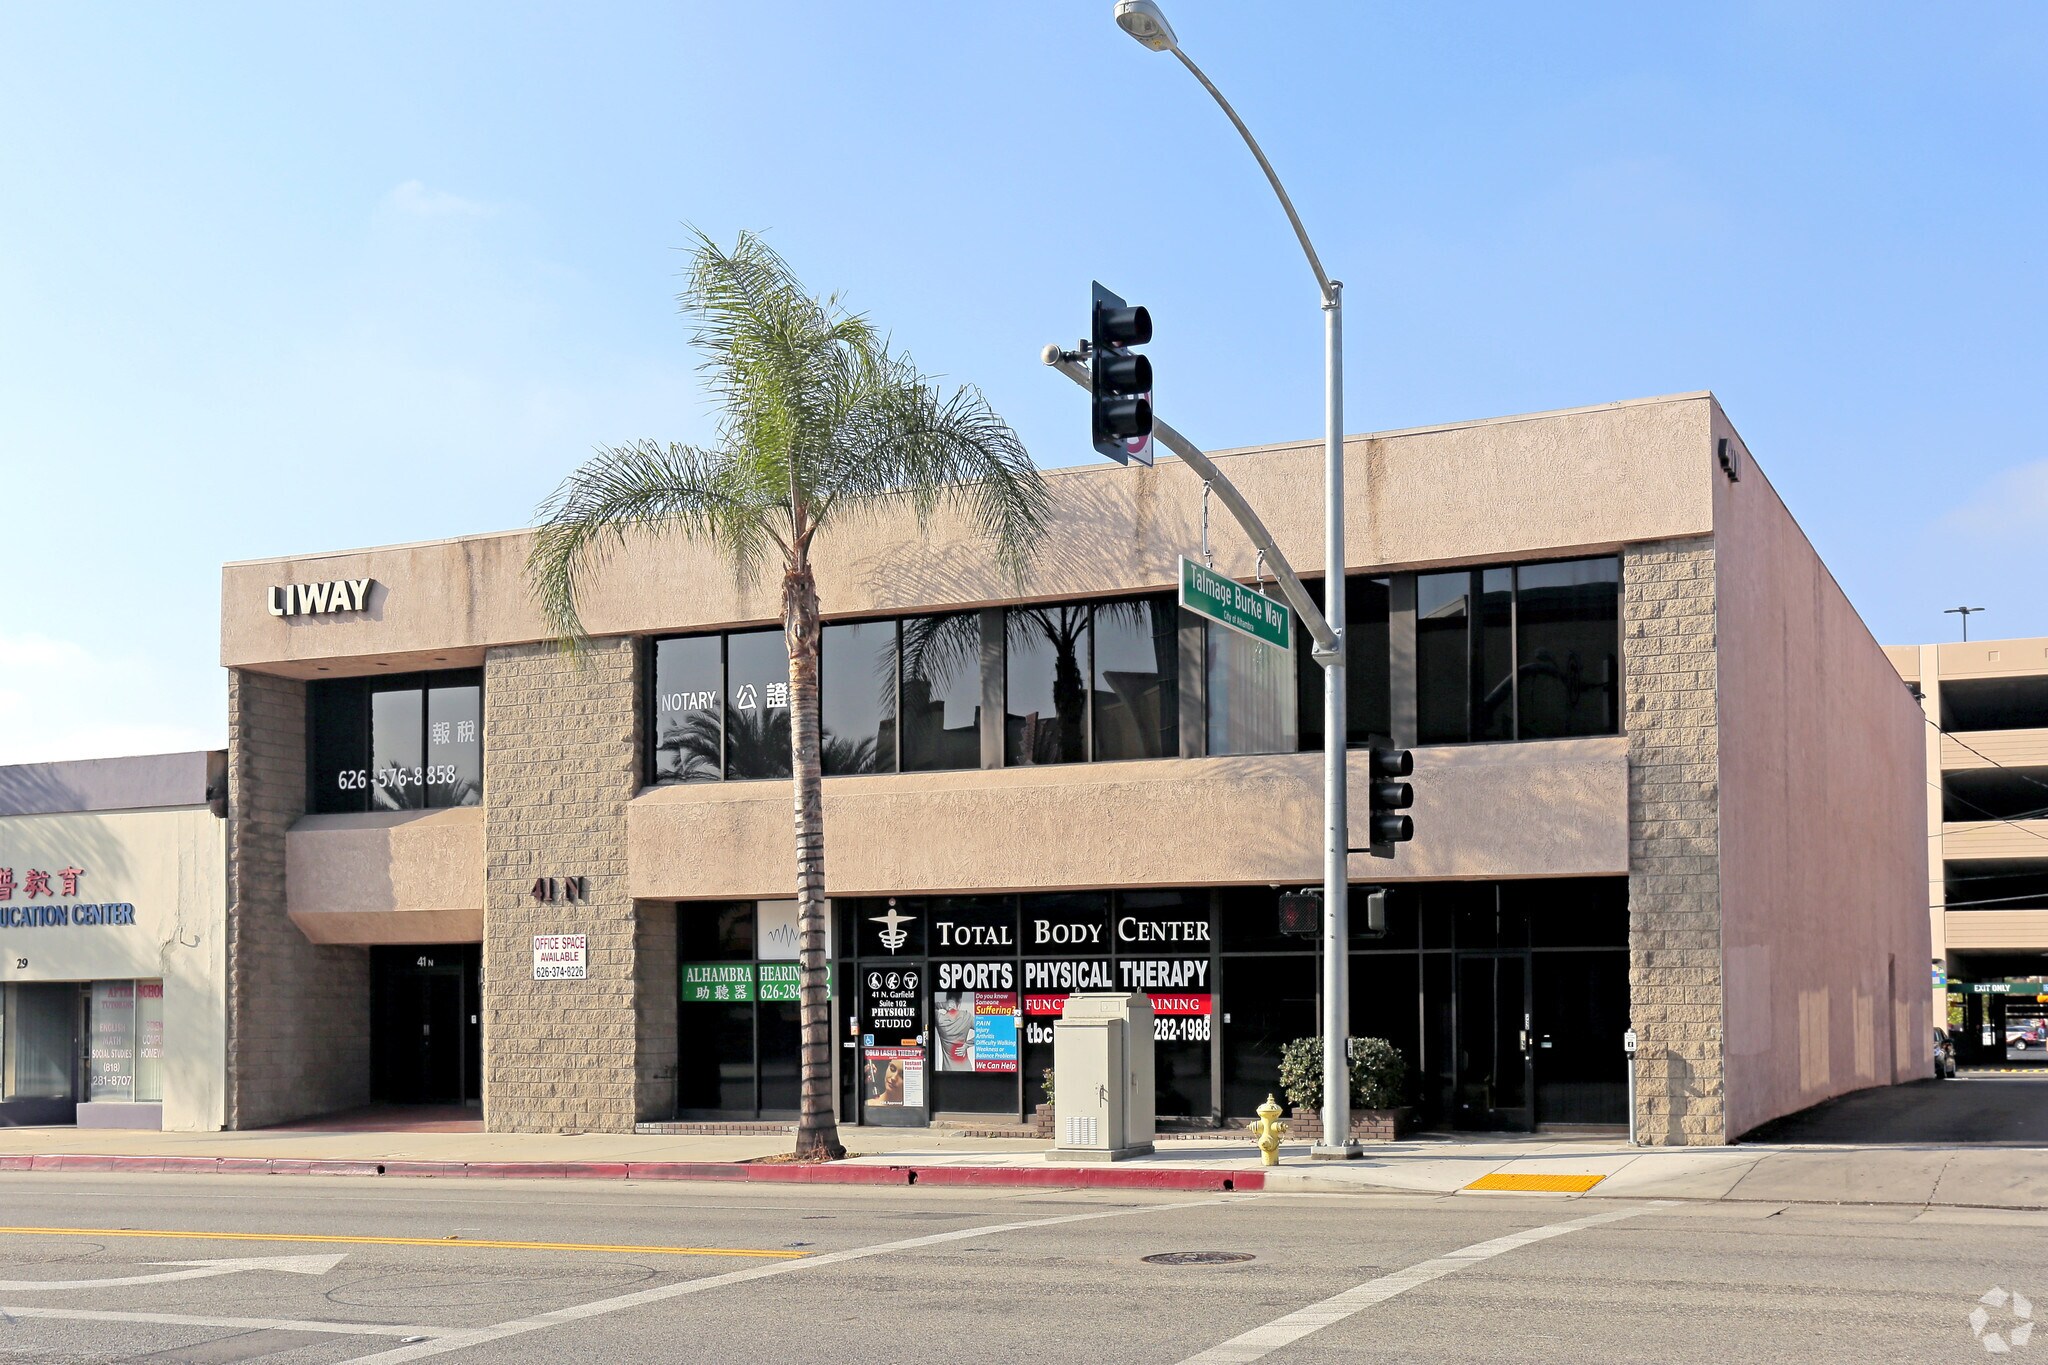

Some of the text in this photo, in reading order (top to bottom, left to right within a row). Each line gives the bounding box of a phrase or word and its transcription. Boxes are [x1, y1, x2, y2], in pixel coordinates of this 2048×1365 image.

[267, 577, 373, 617] LIWAY
[1191, 564, 1283, 634] Talmage Burke Way
[1223, 610, 1255, 632] City of Alhambra
[661, 690, 717, 712] NOTARY
[736, 682, 788, 709] 公證
[432, 720, 475, 745] 報稅
[338, 764, 456, 790] 626-576-8858
[530, 876, 584, 901] 41 N
[71, 902, 135, 926] CENTER
[535, 937, 585, 950] OFFICE SPACE
[416, 956, 434, 967] 41 N
[541, 952, 579, 962] AVAILABLE
[16, 958, 28, 969] 29
[686, 966, 801, 982] ALHAMBRA HEARIN
[939, 960, 1209, 989] SPORTS PHYSICAL THERAPY
[696, 984, 748, 1000] 助聽器
[890, 990, 915, 998] Garfield
[1974, 984, 2011, 992] EXIT ONLY
[871, 1008, 915, 1017] PHYSIQUE
[976, 1006, 1016, 1016] Suffering?
[99, 1023, 126, 1032] ENGLISH
[874, 1019, 912, 1028] STUDIO
[1153, 1018, 1211, 1041] 282-1988
[102, 1036, 122, 1045] MATH
[92, 1048, 132, 1059] SOCIAL STUDIES
[103, 1062, 121, 1072] (818)
[1000, 1062, 1016, 1070] Help
[92, 1075, 132, 1086] 281-8707
